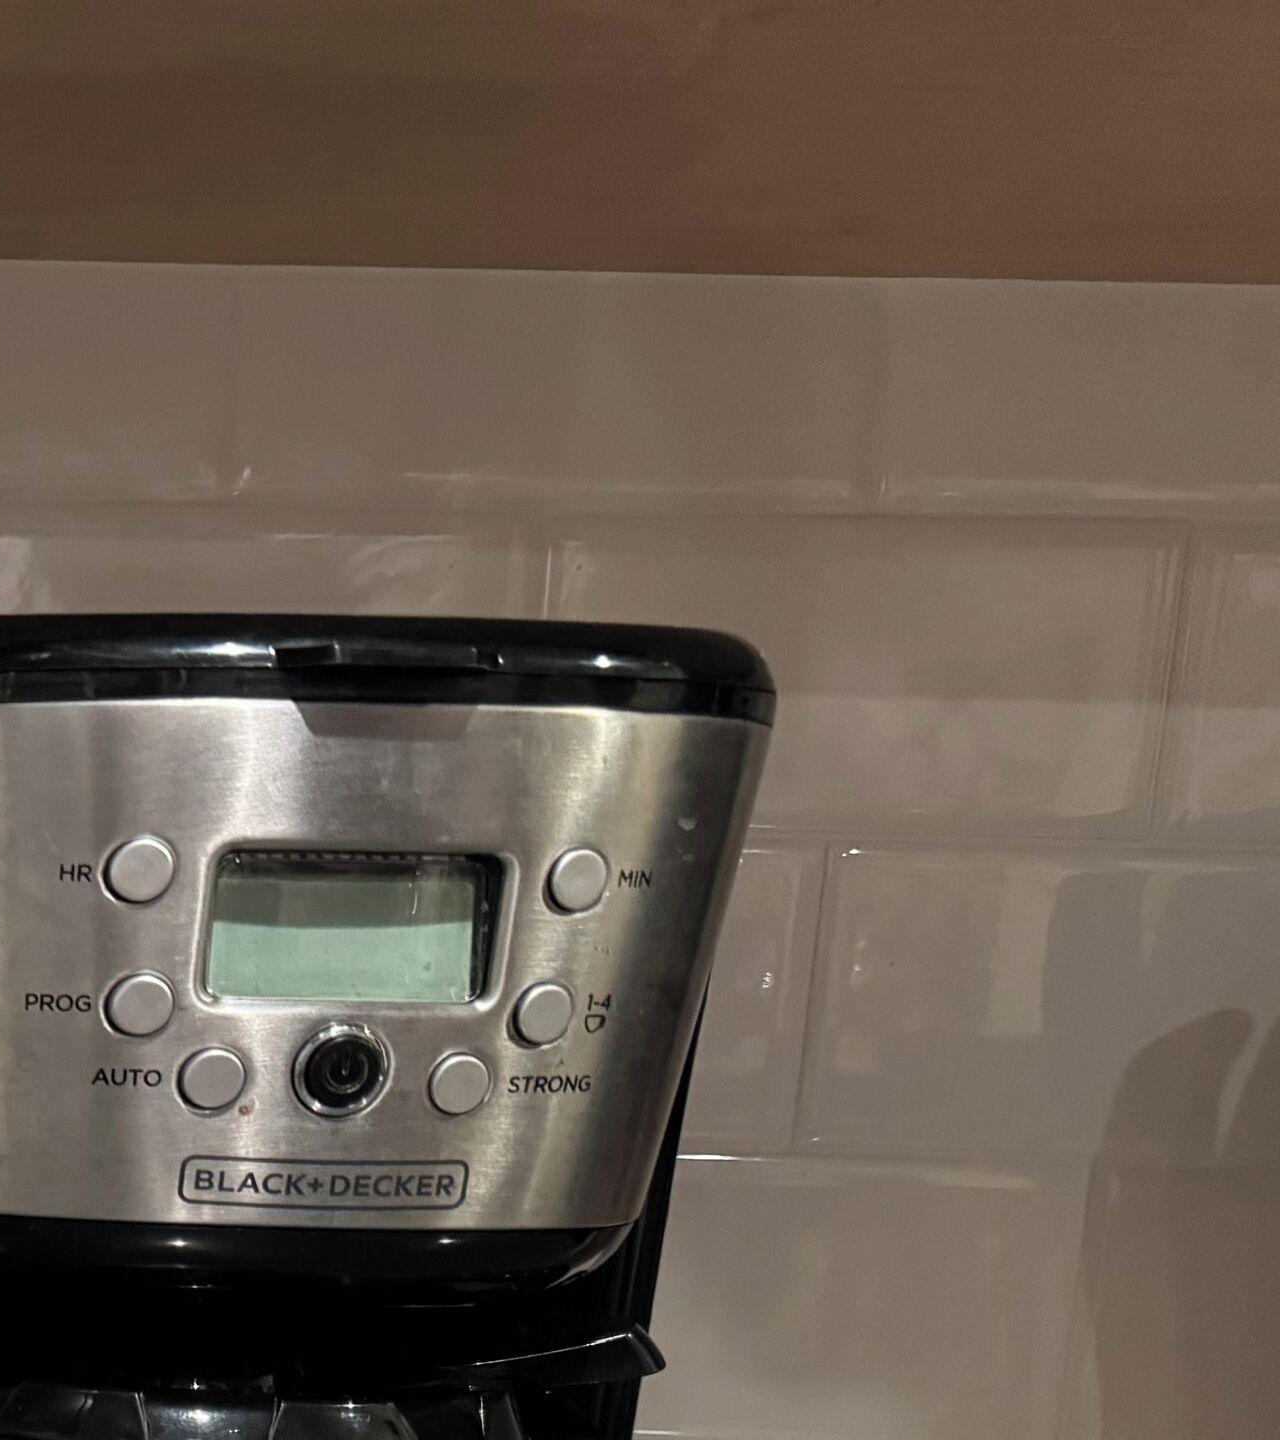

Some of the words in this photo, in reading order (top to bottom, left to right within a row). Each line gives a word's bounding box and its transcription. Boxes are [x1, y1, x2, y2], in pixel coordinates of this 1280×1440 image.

[60, 864, 93, 884] HR
[618, 868, 652, 890] MIN
[25, 993, 92, 1014] PROG
[92, 1068, 162, 1088] AUTO
[507, 1075, 592, 1095] STRONG
[193, 1167, 456, 1198] BLACK+DECKER
